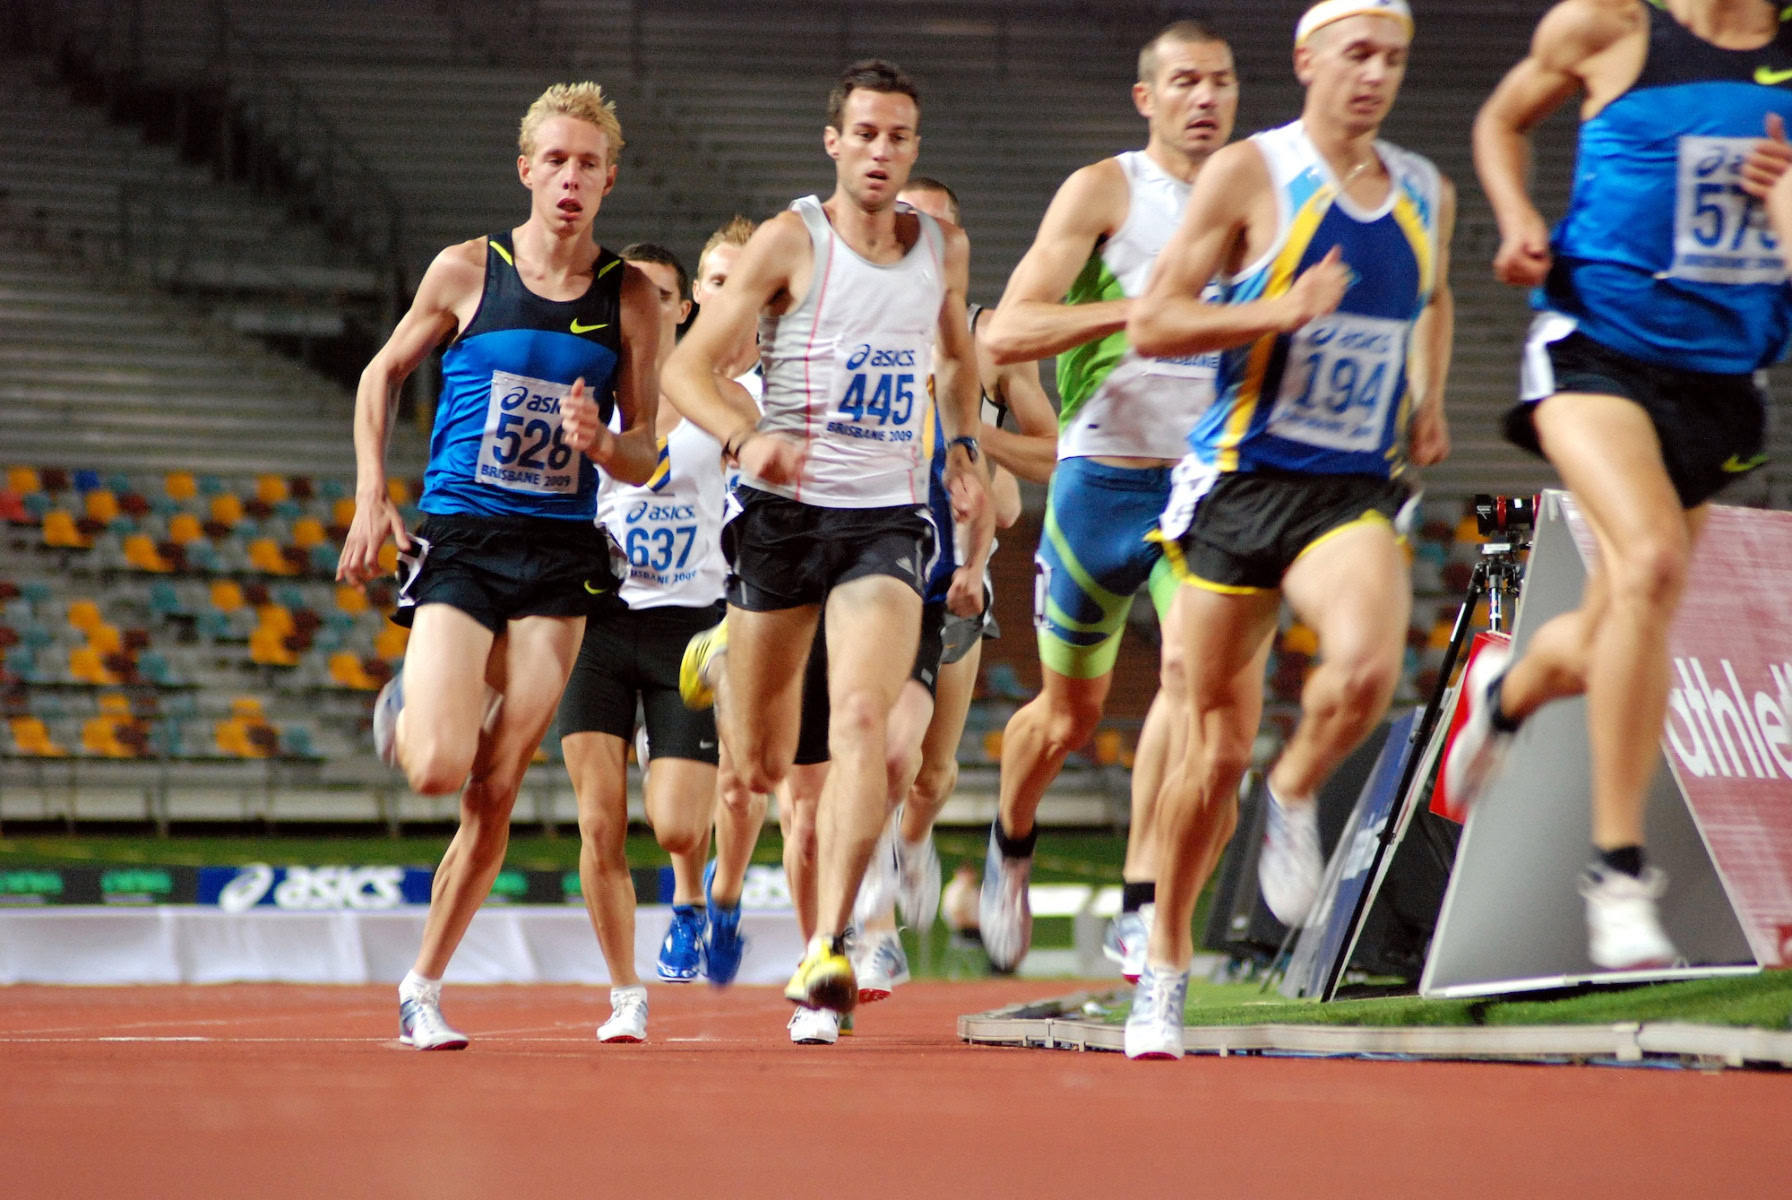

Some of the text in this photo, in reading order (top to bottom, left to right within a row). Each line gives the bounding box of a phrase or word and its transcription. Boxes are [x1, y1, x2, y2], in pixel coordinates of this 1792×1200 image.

[870, 349, 915, 367] asics
[838, 373, 915, 426] 445
[1295, 351, 1386, 415] 194
[492, 412, 572, 470] 528
[827, 421, 913, 443] BRISBANE 2009
[481, 464, 571, 488] BRISBANE 2009
[648, 504, 696, 521] asics
[626, 525, 697, 572] 637
[274, 865, 405, 909] asics
